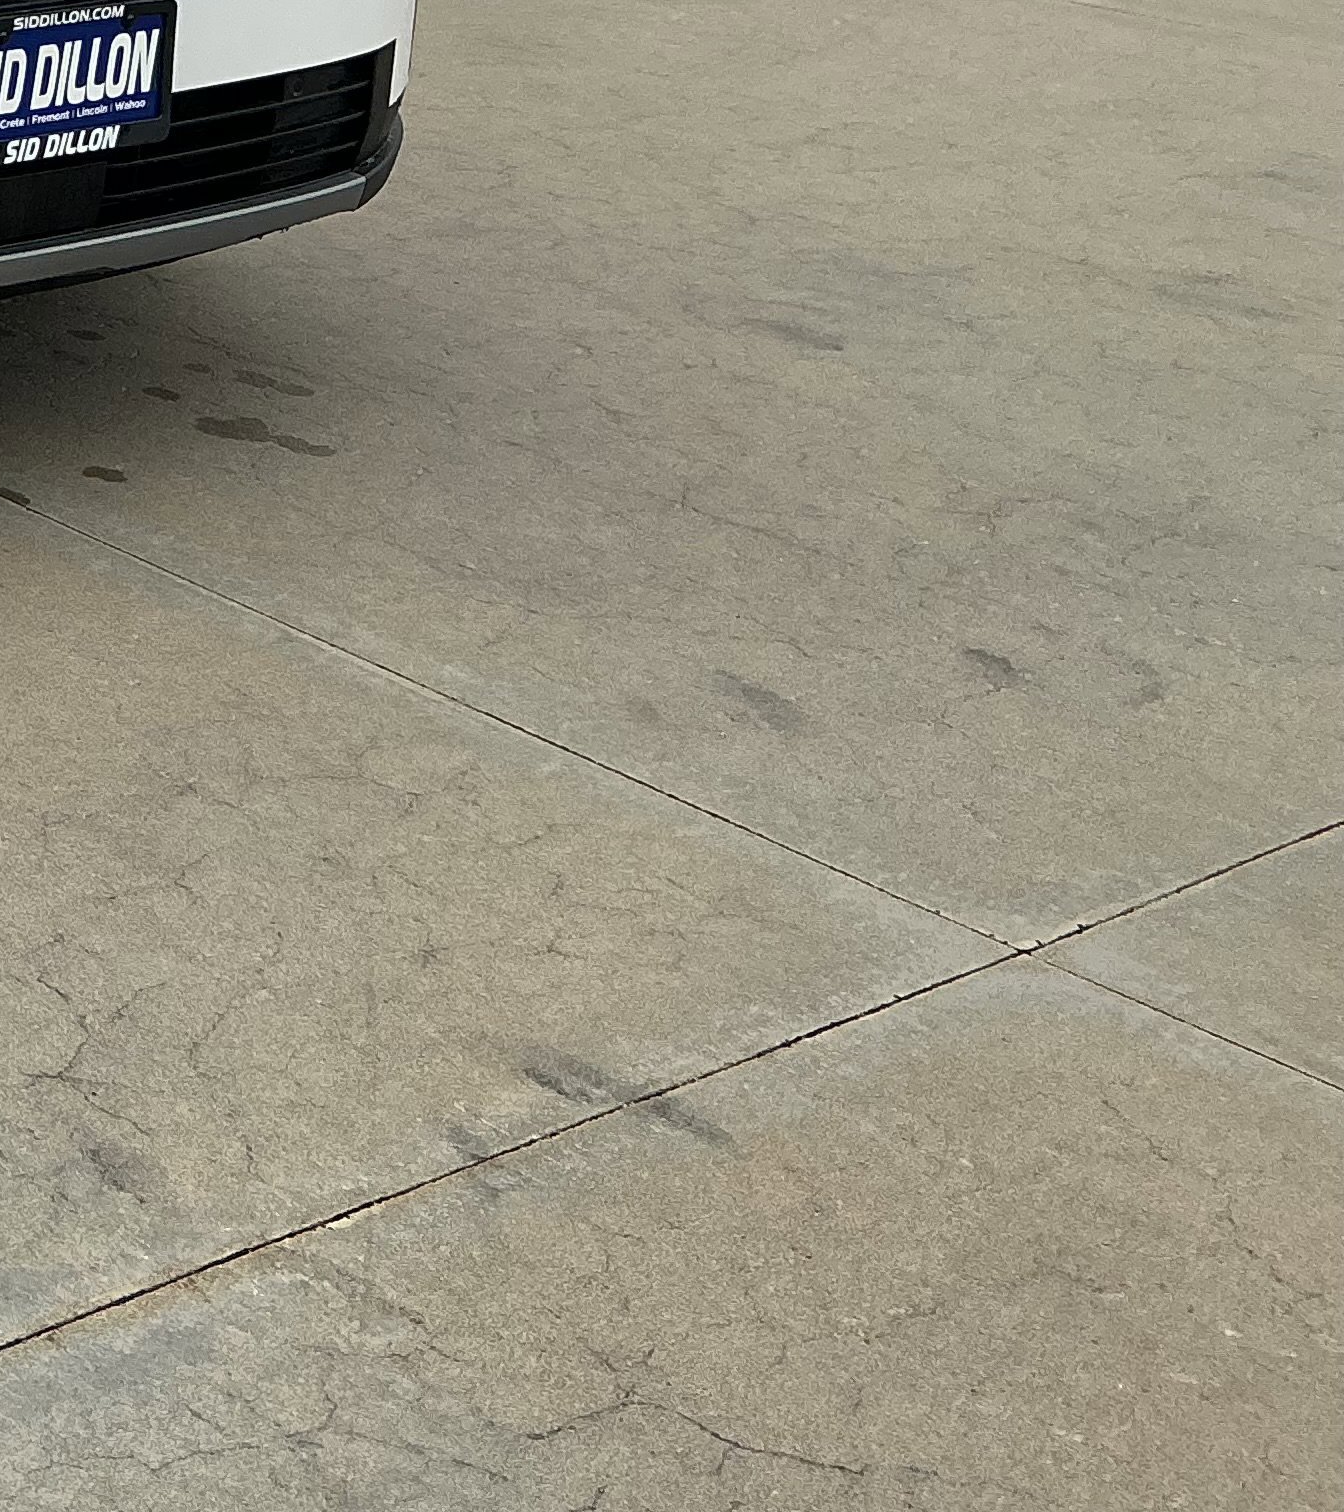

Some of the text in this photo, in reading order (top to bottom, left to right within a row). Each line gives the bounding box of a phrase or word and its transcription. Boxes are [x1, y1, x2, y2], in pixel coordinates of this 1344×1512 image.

[13, 5, 125, 30] SIDDILLON.COM
[30, 29, 160, 110] DILLON
[0, 117, 25, 129] Crete
[32, 110, 70, 124] Fremont
[76, 104, 108, 117] Lincoln
[115, 99, 146, 111] Wahoo
[3, 125, 120, 164] SID DILLON
